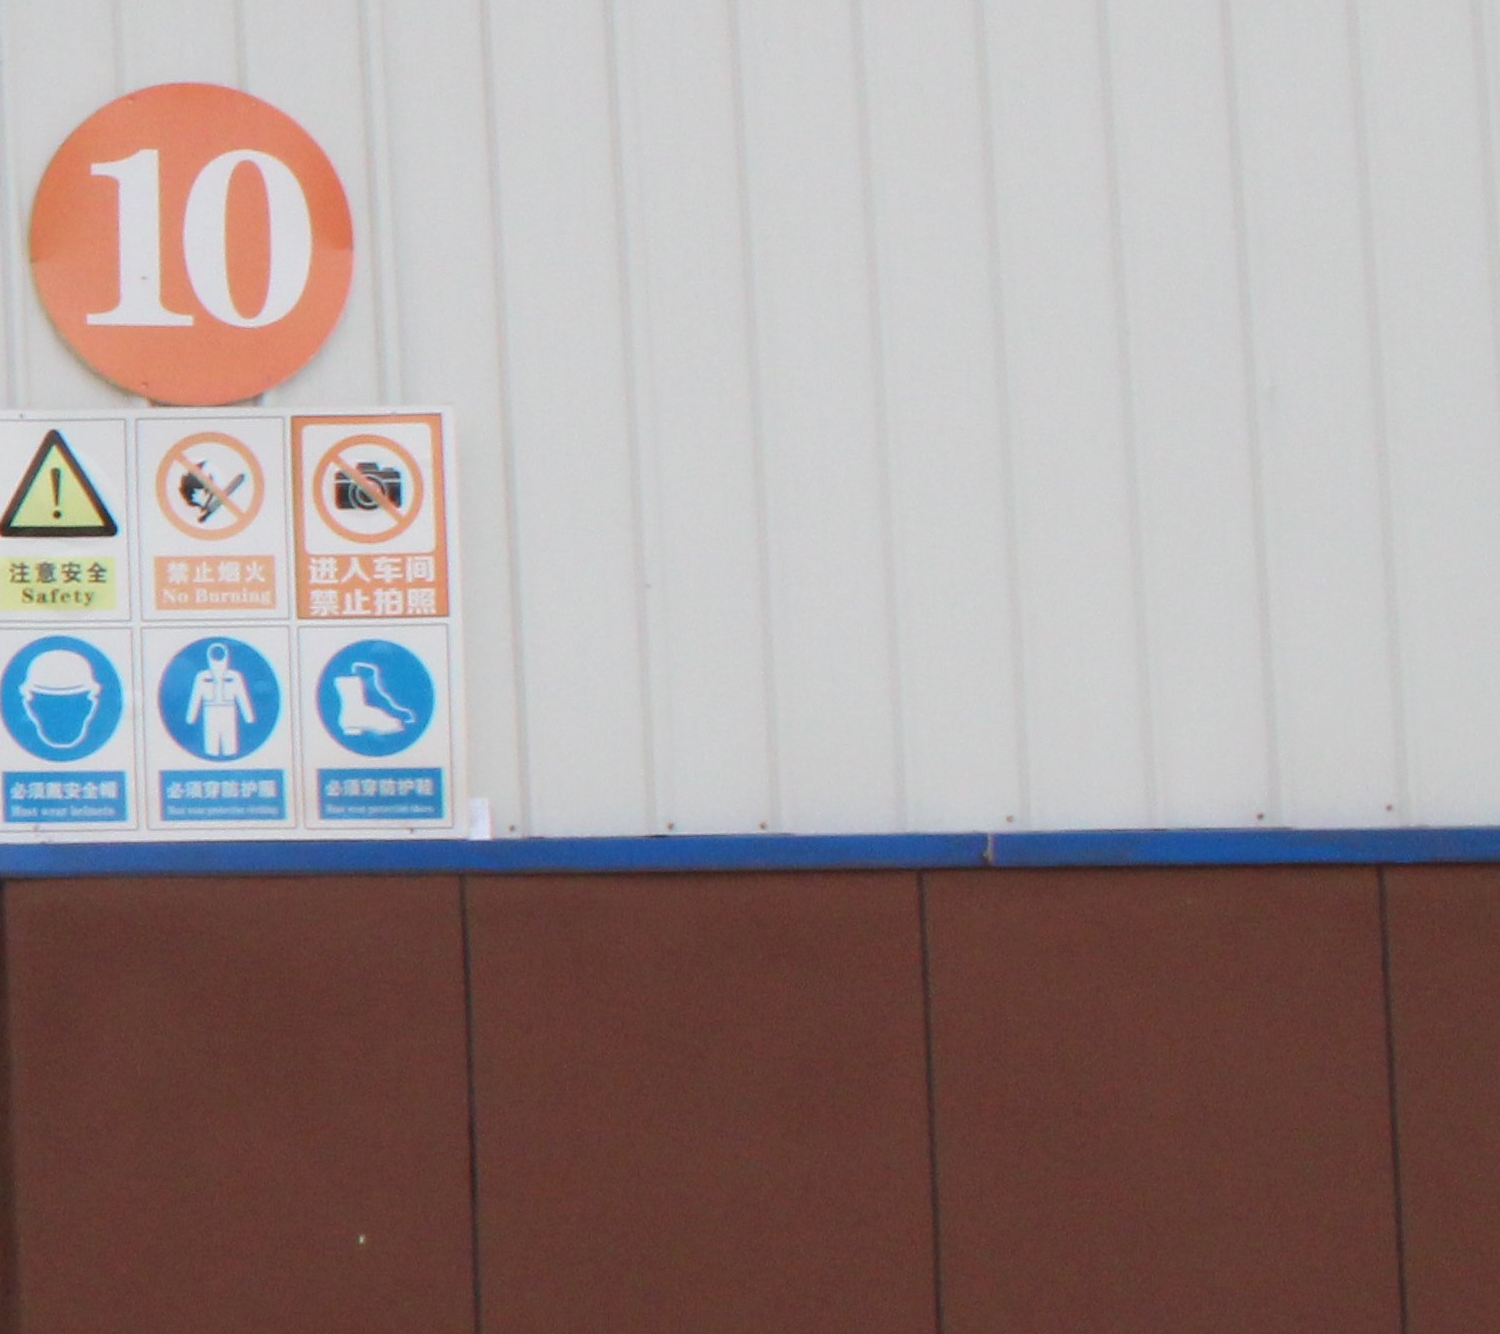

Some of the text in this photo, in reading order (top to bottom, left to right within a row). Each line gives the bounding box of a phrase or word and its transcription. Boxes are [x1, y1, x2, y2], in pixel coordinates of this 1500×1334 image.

[86, 148, 312, 328] 10
[8, 561, 108, 584] 注意安全
[166, 561, 266, 584] 禁止烟火
[308, 555, 436, 584] 进入车间
[21, 588, 95, 606] Safety
[162, 587, 271, 605] No Burning
[308, 587, 437, 616] 禁止拍照
